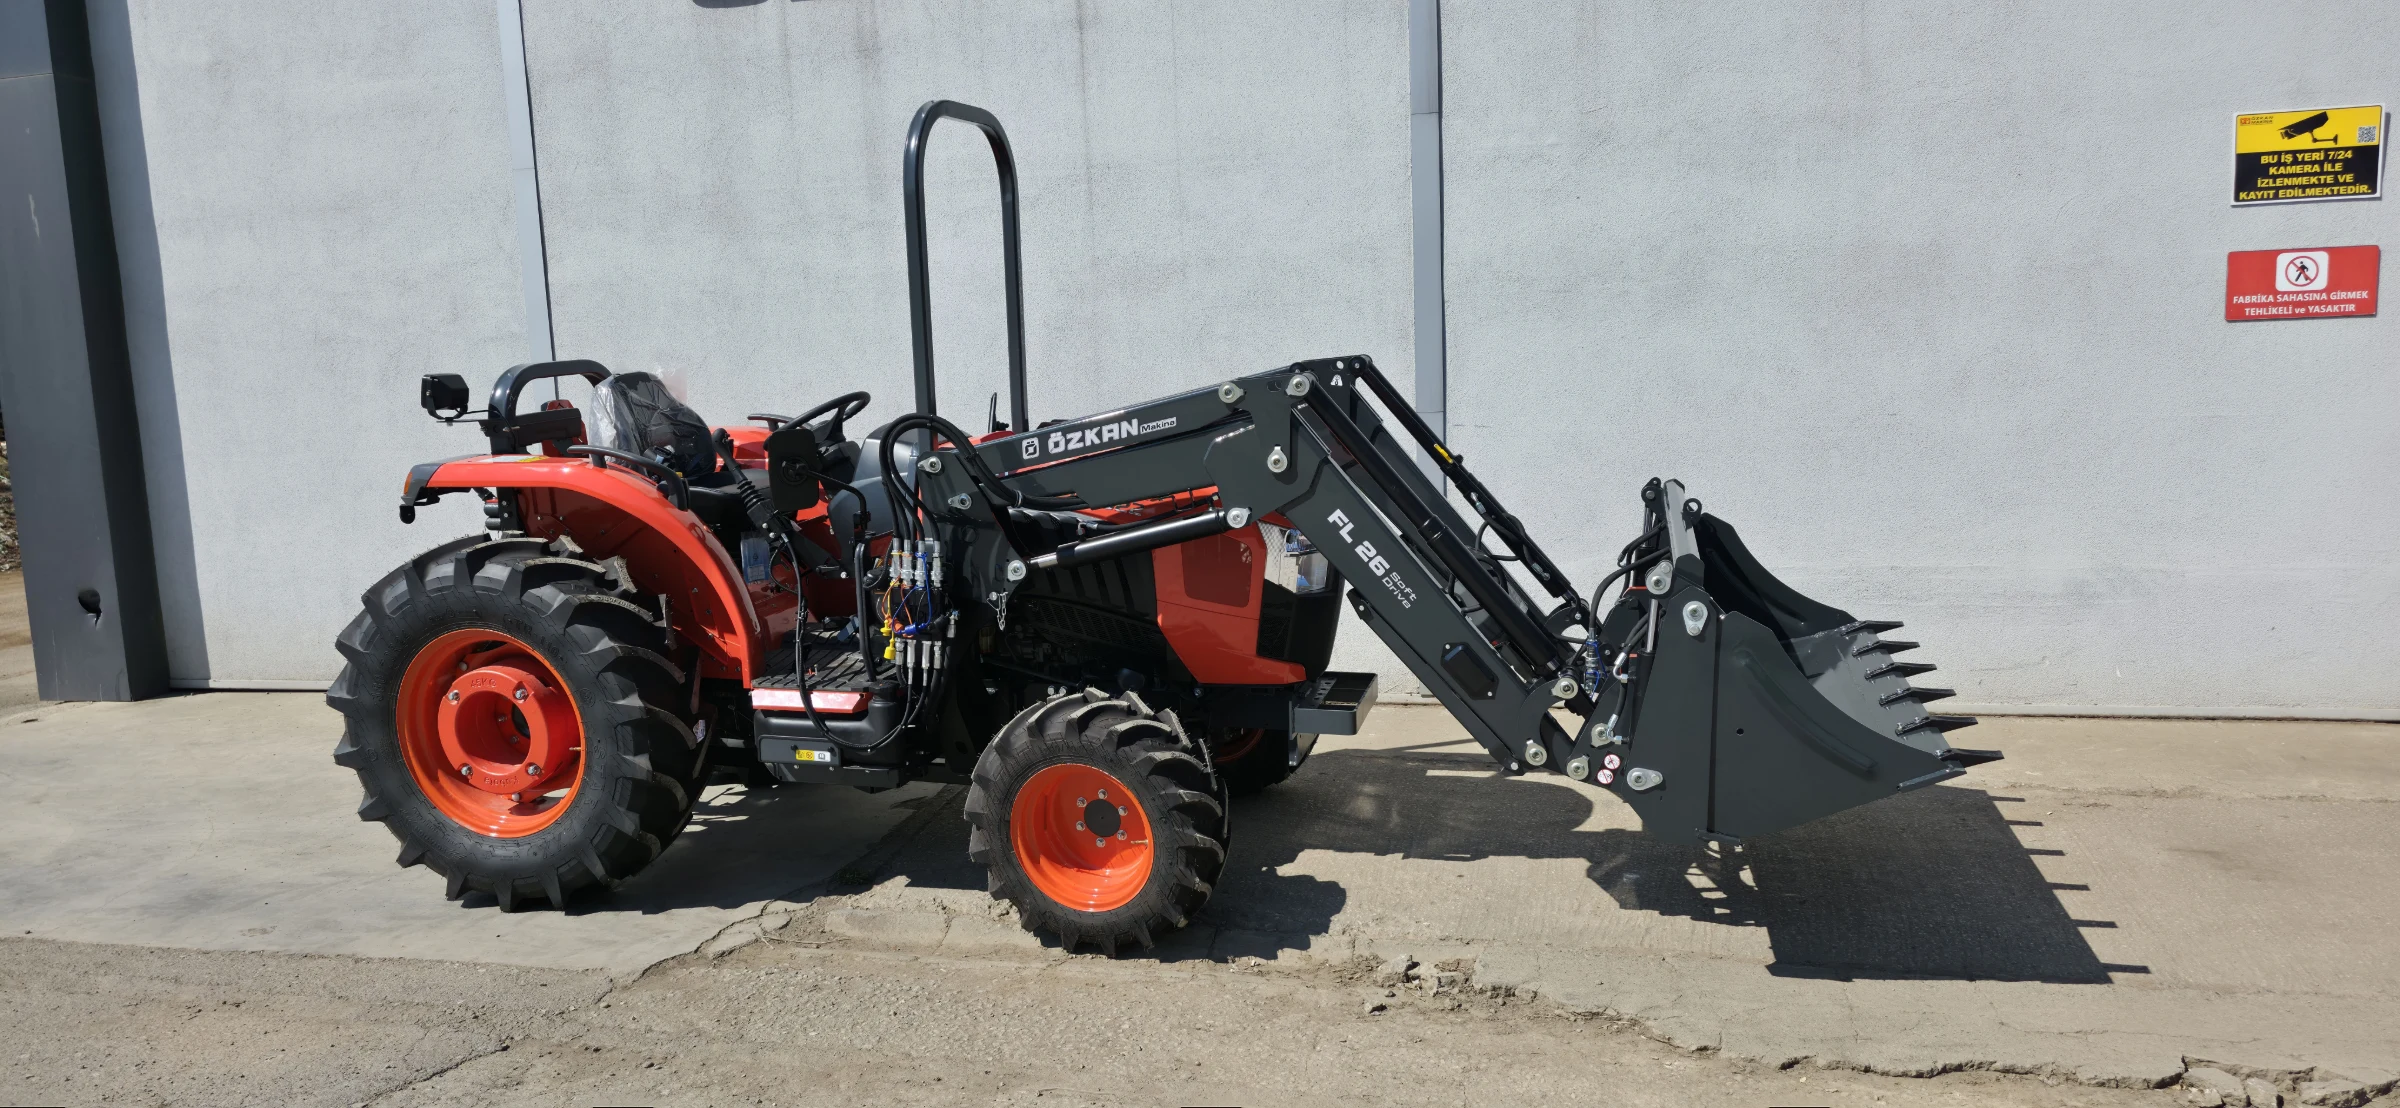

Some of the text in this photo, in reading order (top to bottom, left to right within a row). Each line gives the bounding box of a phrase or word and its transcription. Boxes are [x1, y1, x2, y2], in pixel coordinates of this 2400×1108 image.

[2261, 150, 2353, 164] BU İŞ YERİ 7/24
[2269, 162, 2343, 175] KAMERA İLE
[2257, 174, 2354, 187] İZLENMEKTE VE
[2239, 184, 2372, 200] KAYIT EDİLMEKTEDİR.
[2233, 290, 2368, 304] FABRİKA SAHASINA GİRMEK
[2245, 305, 2293, 316] TEHLİKELİ
[2308, 304, 2356, 312] YASAKTIR
[1048, 418, 1138, 454] ÖZKAN
[1327, 508, 1390, 577] FL 26
[1382, 577, 1411, 609] Drive
[1389, 572, 1417, 601] Soft
